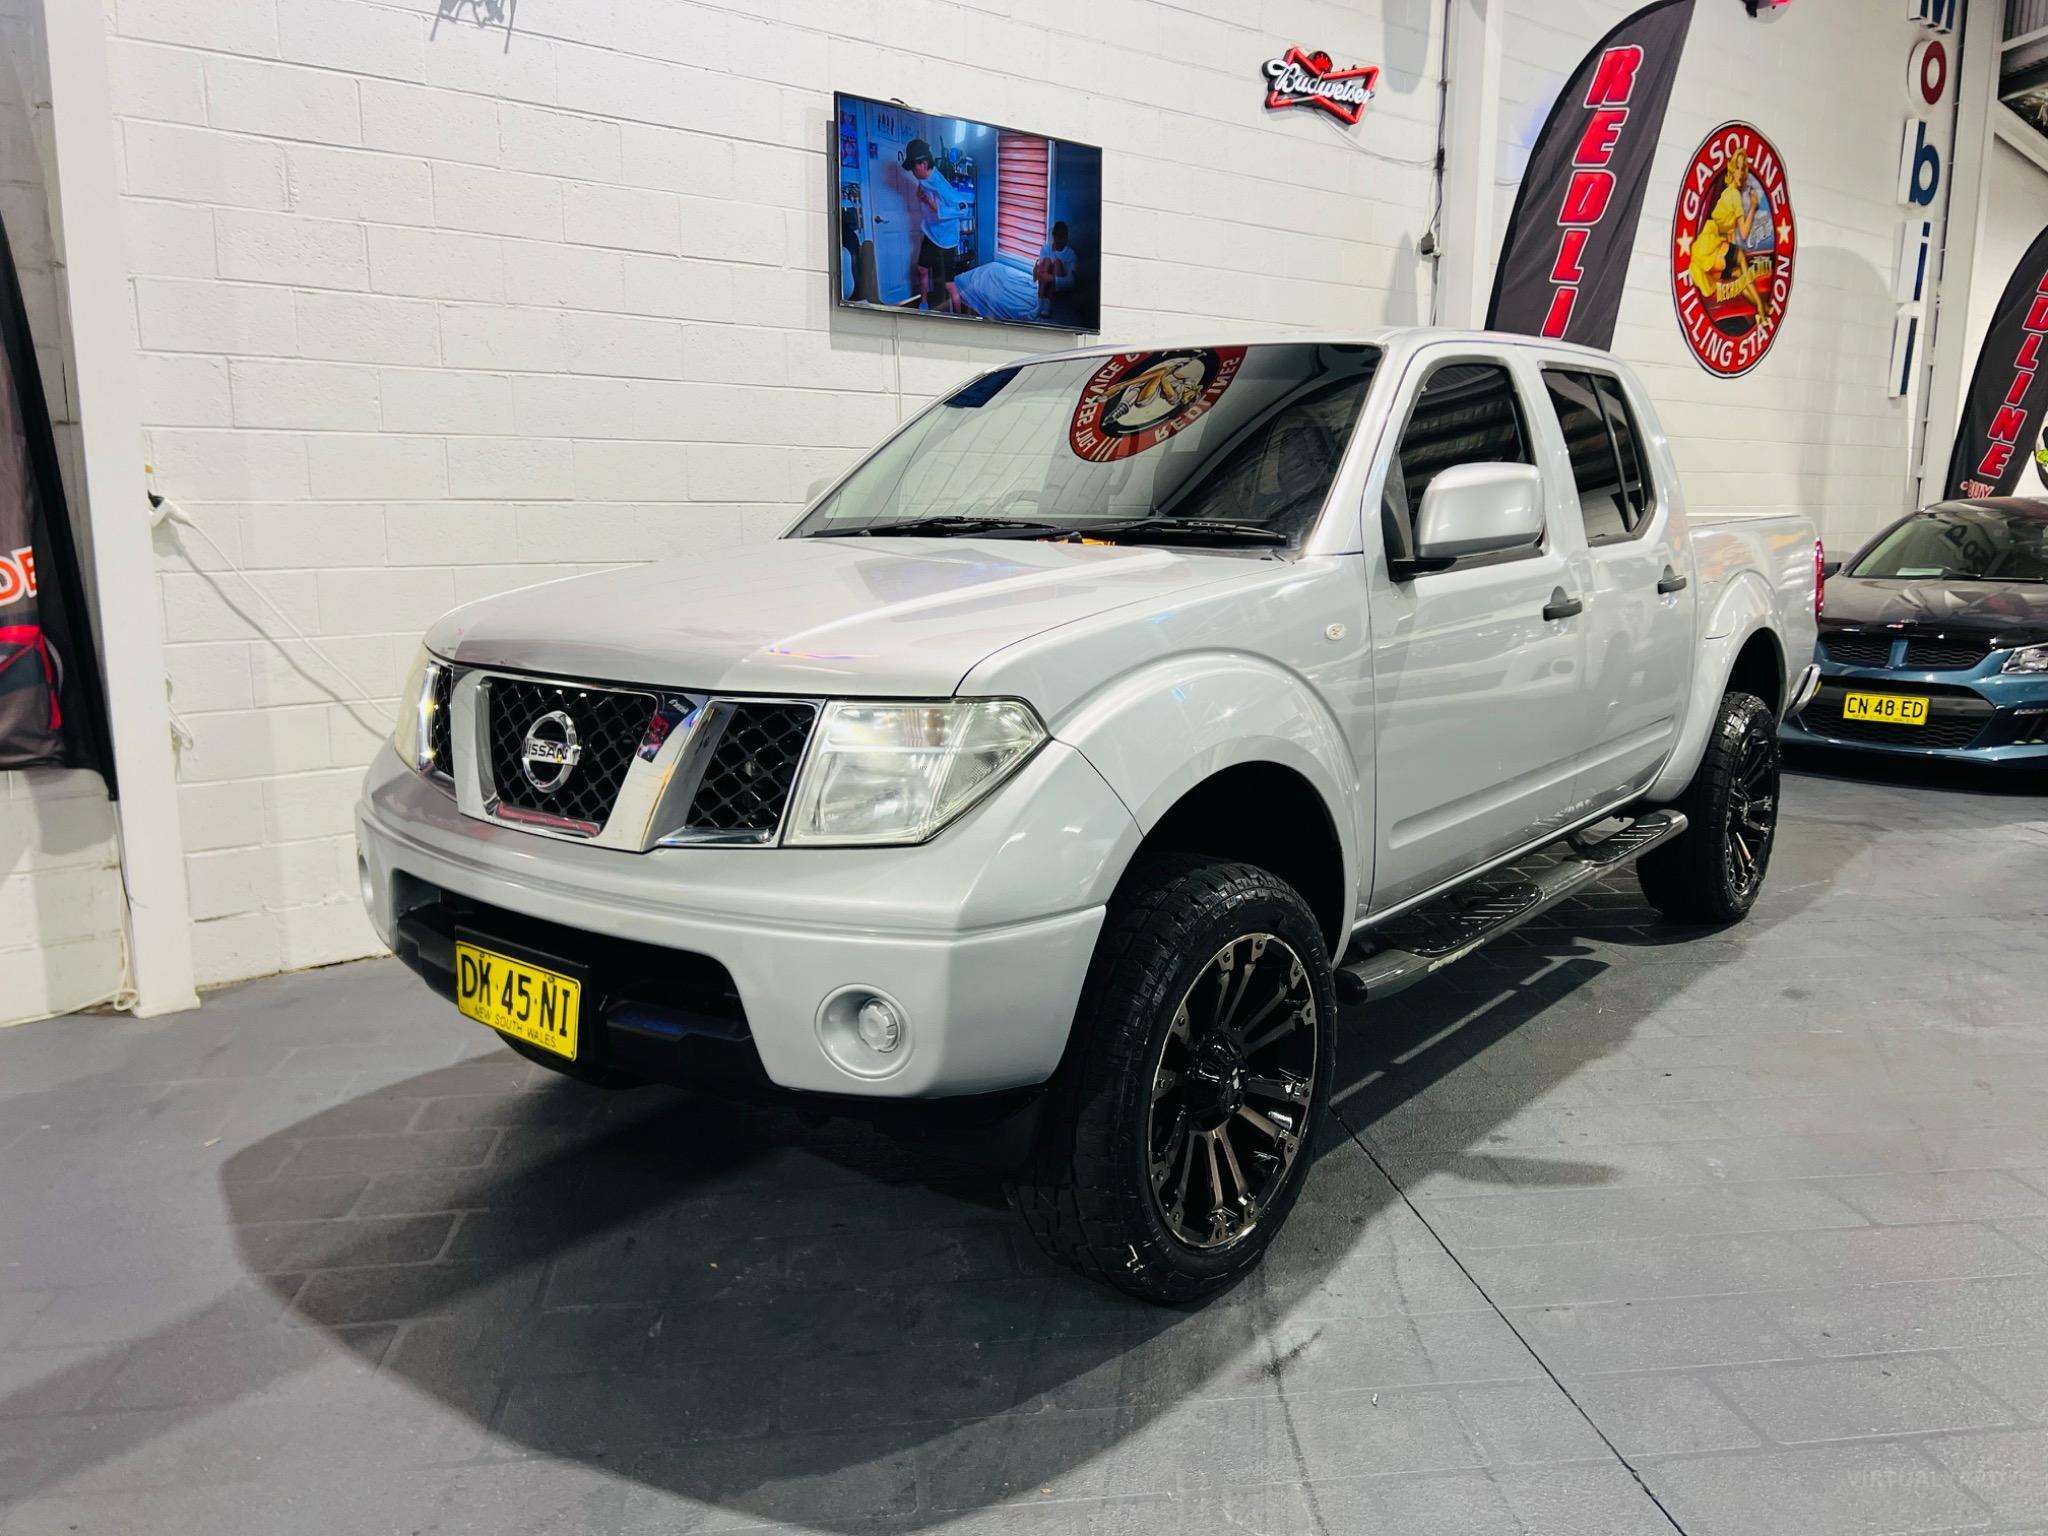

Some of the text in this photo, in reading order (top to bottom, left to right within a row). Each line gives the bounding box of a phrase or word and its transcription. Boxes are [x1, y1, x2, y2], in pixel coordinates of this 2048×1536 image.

[1267, 59, 1371, 104] Budweiser
[1683, 132, 1786, 221] GASOLINE
[1678, 270, 1733, 367] FILLING
[1738, 255, 1790, 366] STATION
[1977, 268, 2048, 478] DLINE
[1847, 697, 1924, 718] CN 48 ED
[461, 953, 570, 1038] DK 45 NI
[474, 1005, 556, 1048] NEW SOUTH WALES
